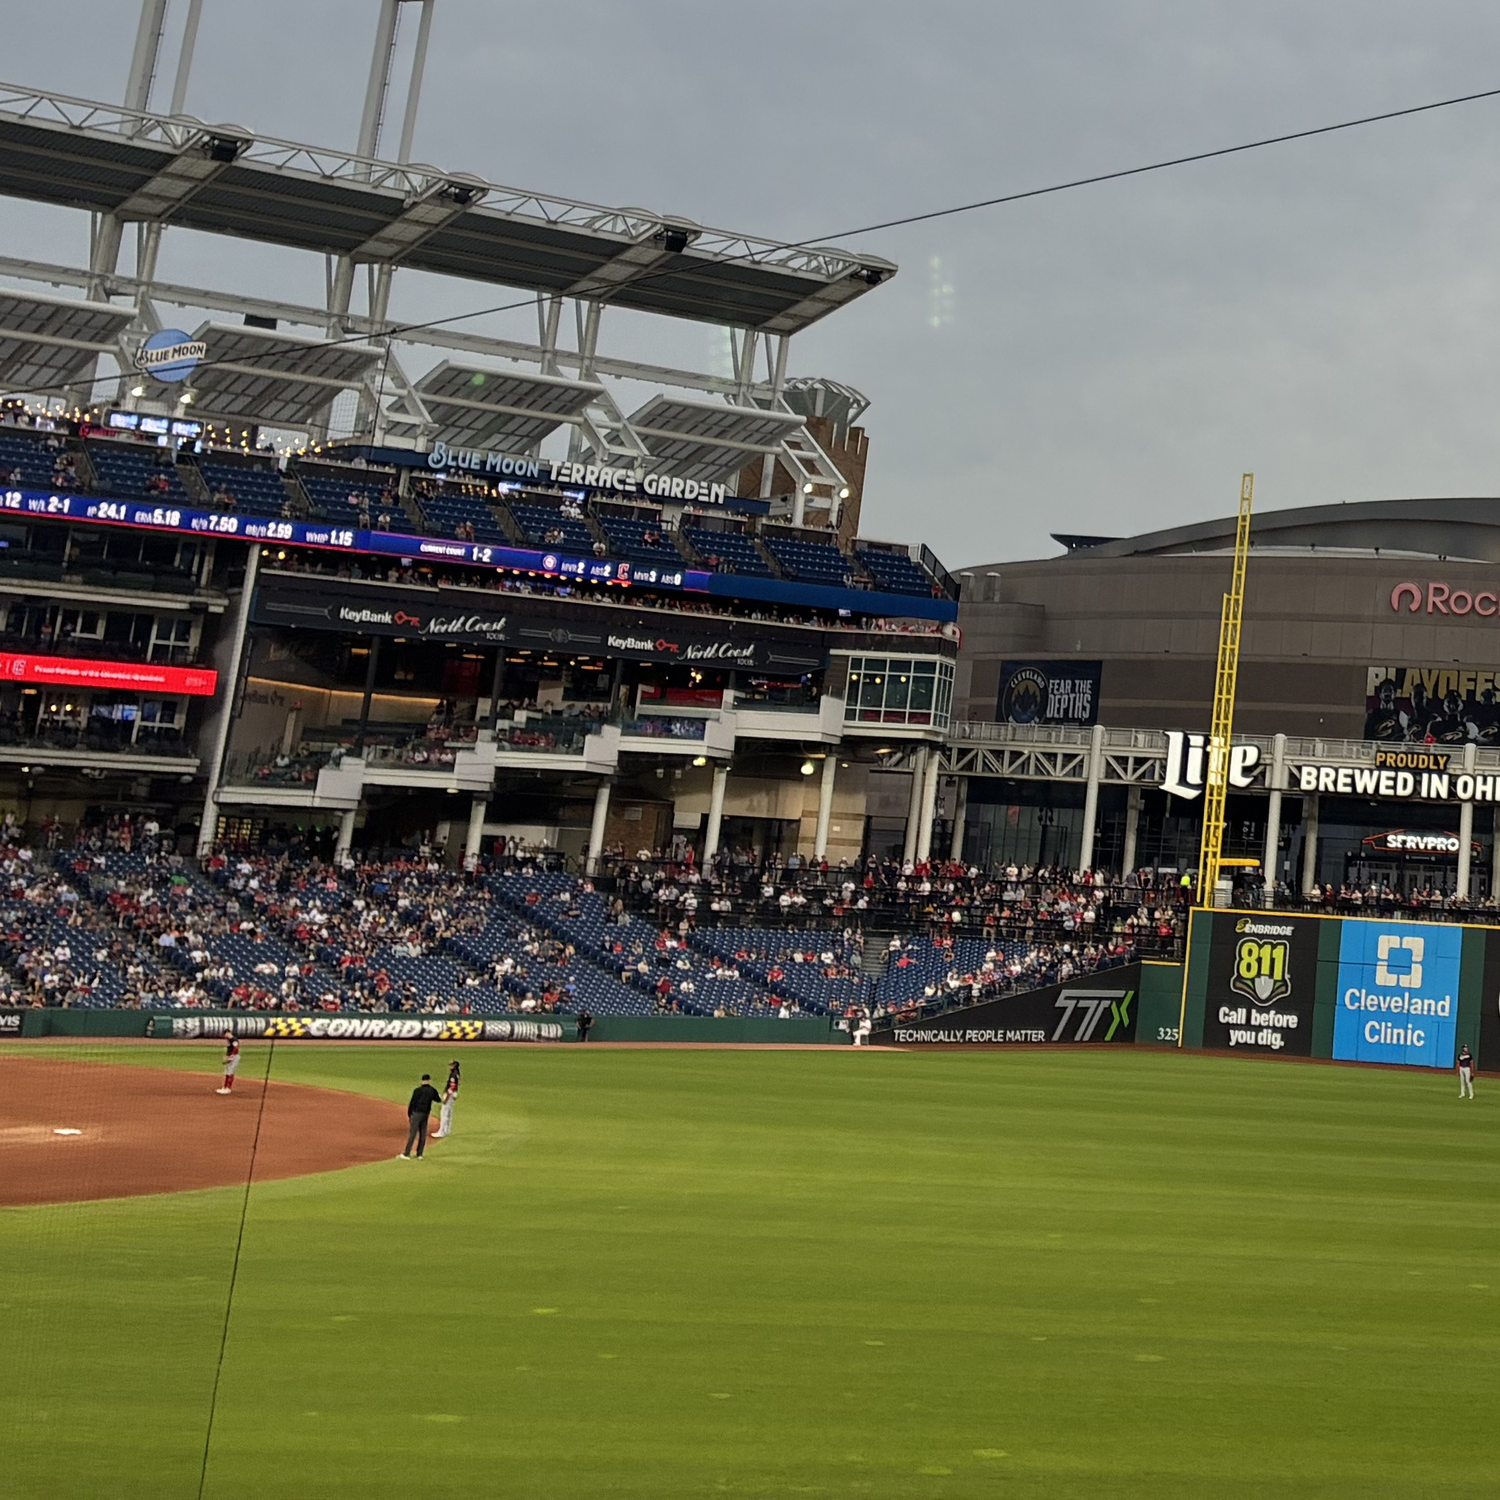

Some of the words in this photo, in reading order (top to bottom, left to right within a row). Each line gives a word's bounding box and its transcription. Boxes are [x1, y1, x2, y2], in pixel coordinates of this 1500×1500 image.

[136, 350, 169, 366] BLUE
[172, 345, 204, 358] MOON
[428, 441, 481, 469] BLUE
[486, 452, 539, 478] MOON
[549, 460, 637, 491] TERRACE
[643, 474, 725, 504] GARDEN
[49, 496, 70, 513] 2-1
[98, 503, 126, 520] 24.1
[153, 509, 180, 526] 5.18
[472, 546, 492, 562] 1-2
[340, 607, 392, 624] KeyBank
[608, 636, 654, 650] KeyBank
[1010, 670, 1045, 689] CLEVELAND
[1049, 679, 1071, 693] FEAR
[1075, 680, 1092, 693] THE
[1046, 693, 1092, 719] DEPTHS
[1159, 731, 1259, 800] Lite
[1376, 751, 1448, 770] PROUDLY
[1301, 766, 1414, 797] BREWED
[1420, 773, 1449, 799] IN
[1387, 834, 1459, 851] SERVPRO
[1244, 924, 1294, 935] ENBRIDGE
[1239, 942, 1285, 980] 811
[1344, 989, 1450, 1017] Cleveland
[1218, 1006, 1246, 1025] Call
[1250, 1012, 1298, 1029] before
[310, 1019, 442, 1039] CONRAD'S
[894, 1030, 963, 1043] TECHNICALLY,
[966, 1030, 1004, 1042] PEOPLE
[1006, 1030, 1045, 1042] MATTER
[1157, 1028, 1178, 1041] 325
[1364, 1021, 1425, 1047] Clinic
[1229, 1030, 1255, 1047] you
[1257, 1032, 1284, 1050] dig.
